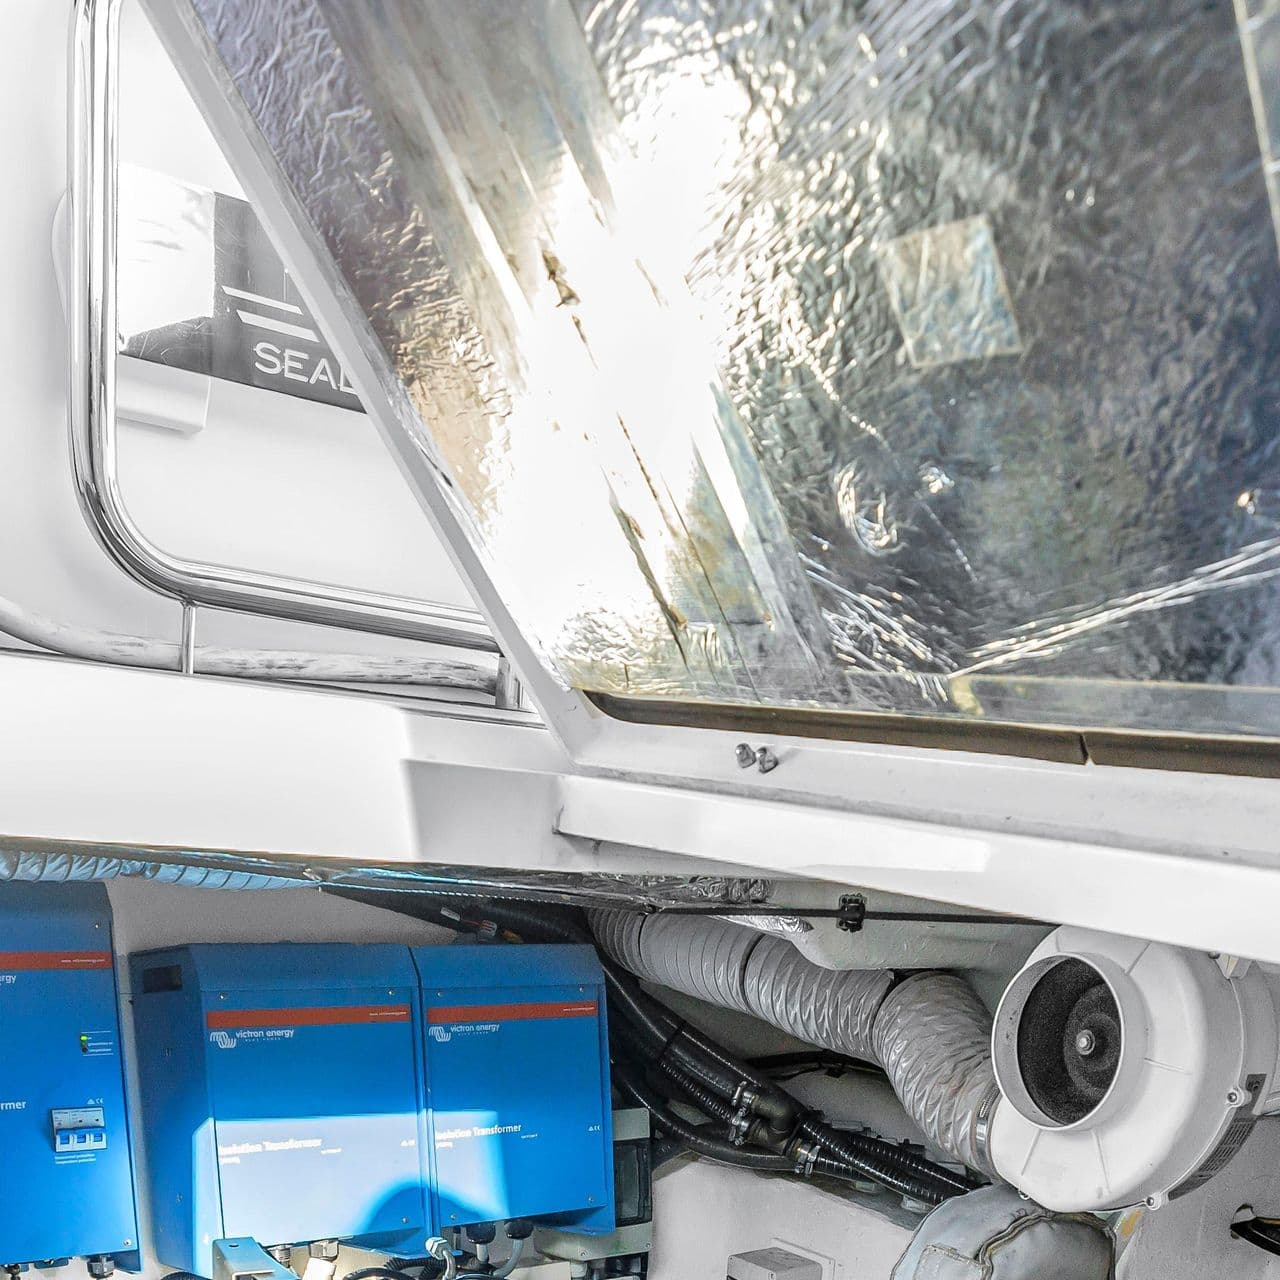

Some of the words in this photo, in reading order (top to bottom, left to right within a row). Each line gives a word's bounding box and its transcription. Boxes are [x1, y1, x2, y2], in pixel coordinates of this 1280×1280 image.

[235, 1029, 265, 1039] victron
[266, 1028, 295, 1039] energy
[449, 1024, 475, 1033] victron
[476, 1023, 501, 1033] energy
[473, 1123, 522, 1137] Transformer
